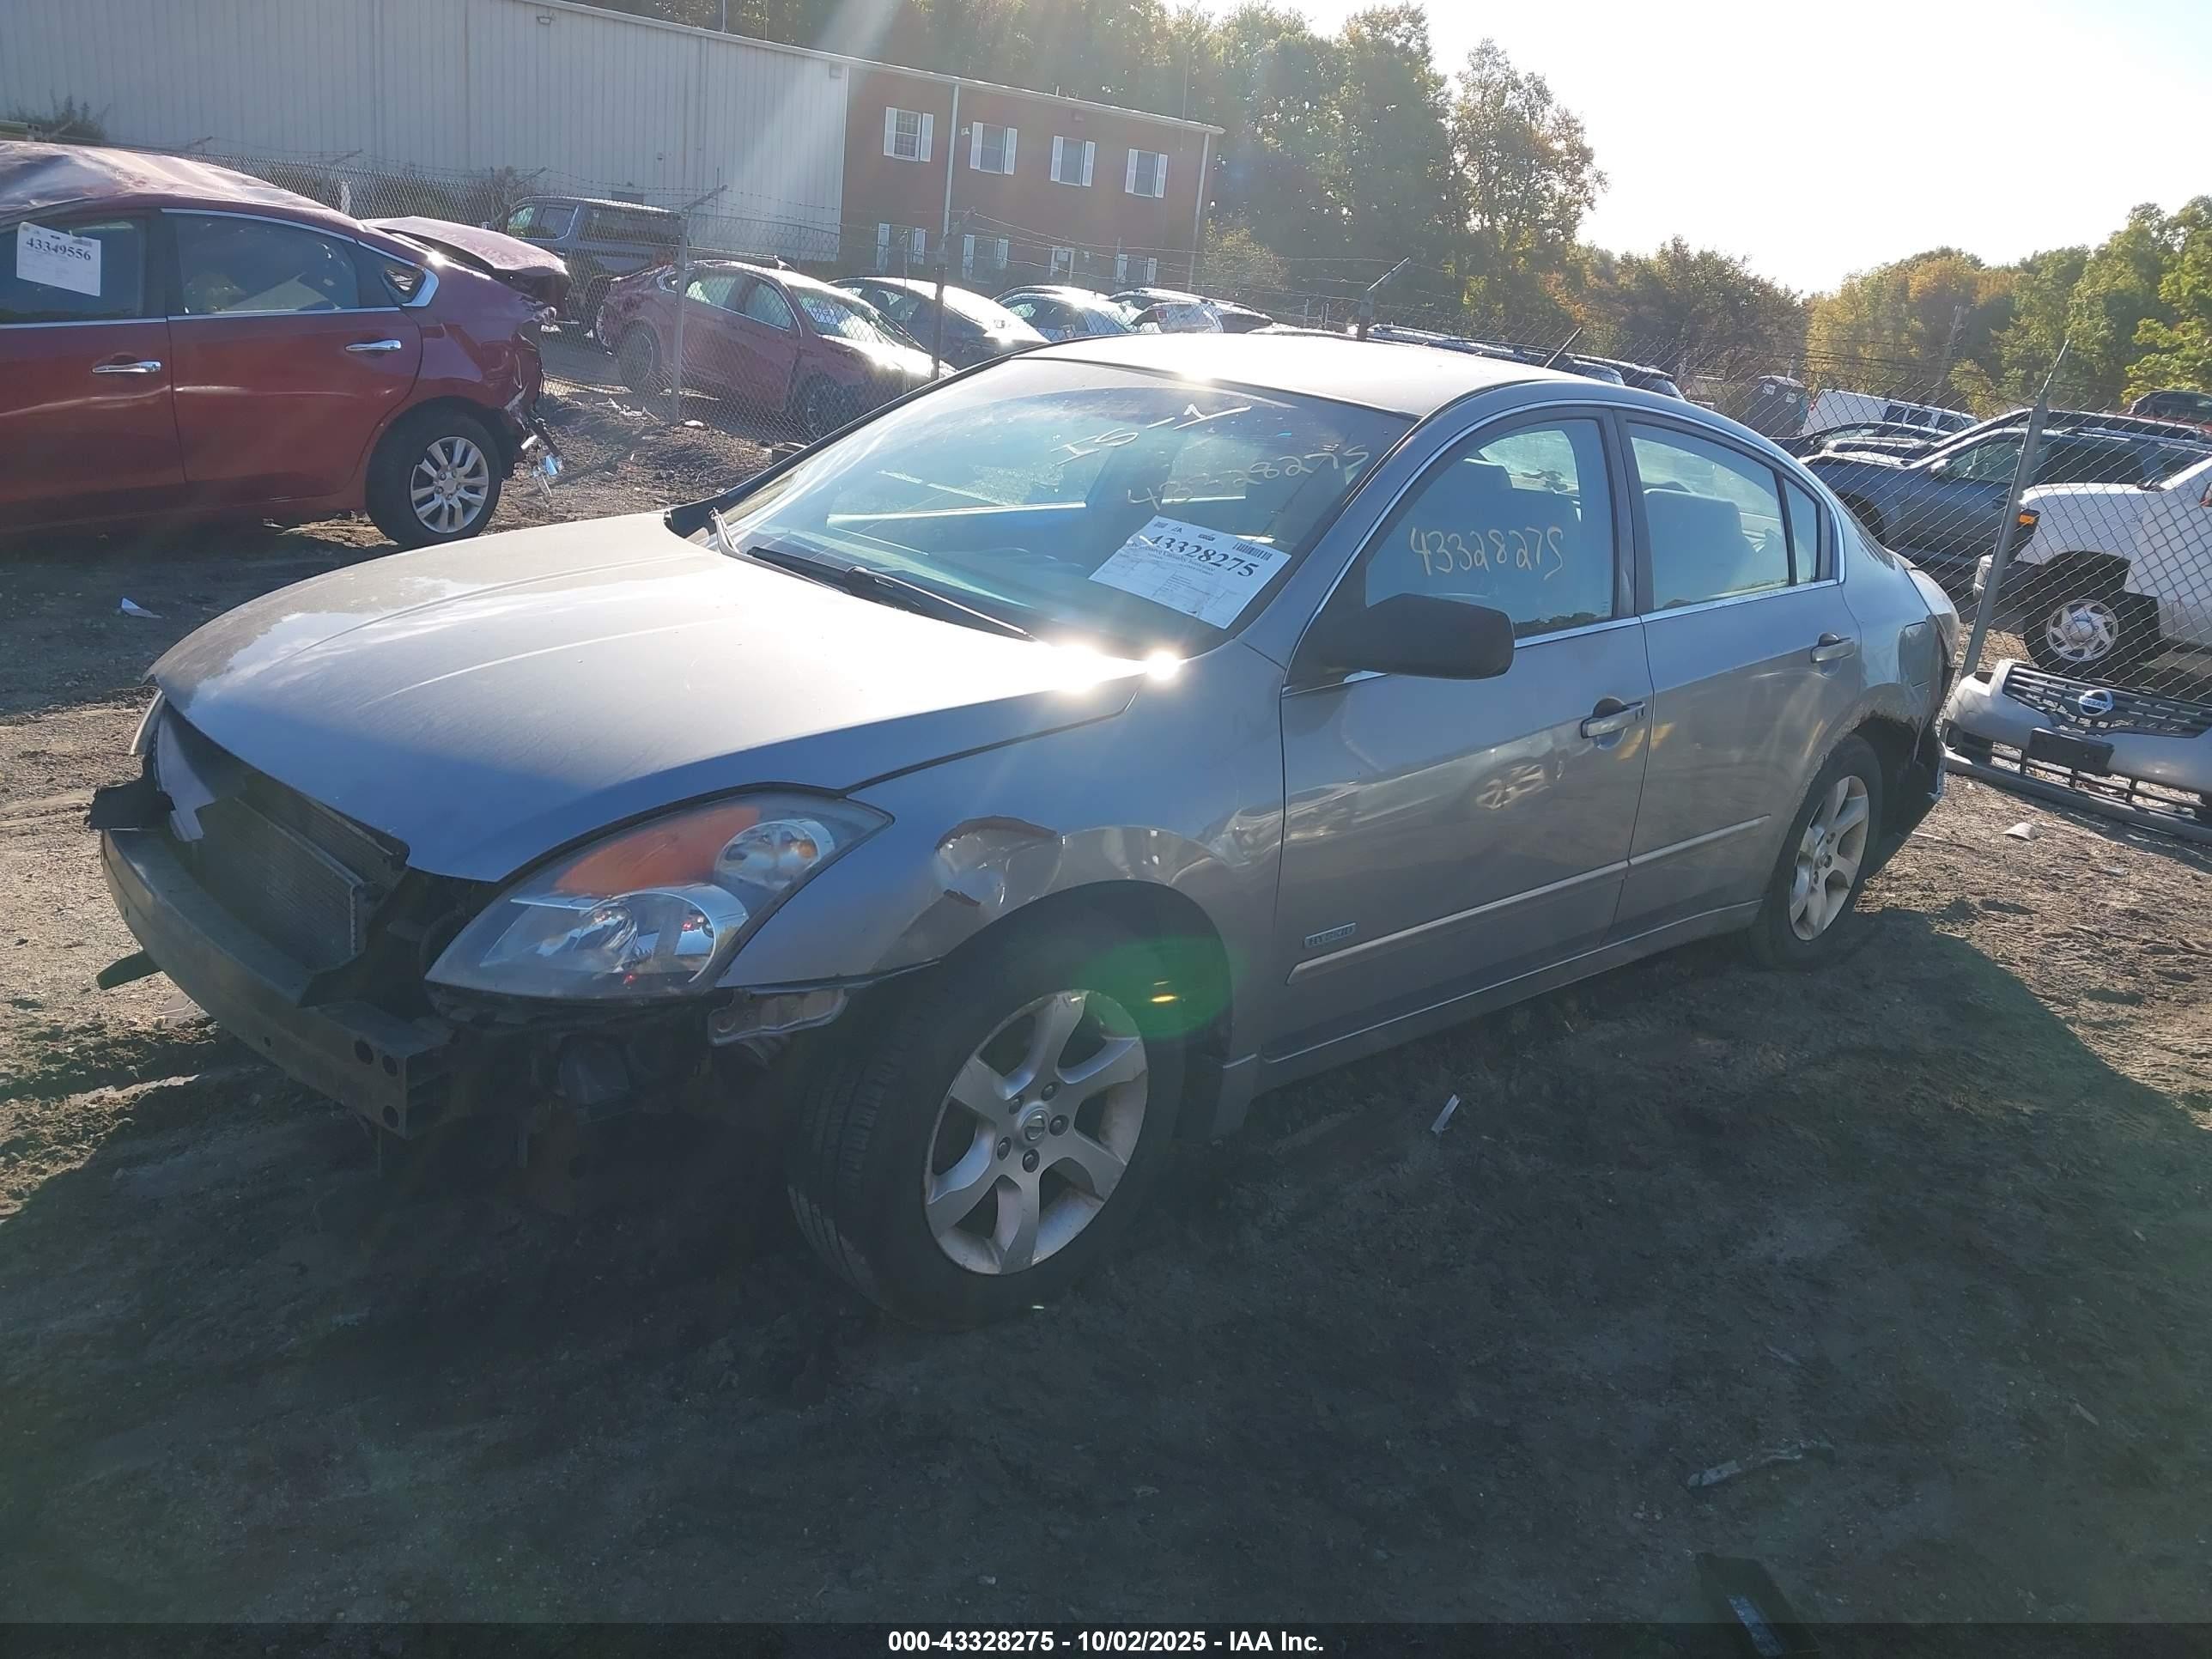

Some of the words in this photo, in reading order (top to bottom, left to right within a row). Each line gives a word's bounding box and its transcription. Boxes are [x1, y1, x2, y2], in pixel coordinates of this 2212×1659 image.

[27, 237, 91, 261] 43349556
[1150, 534, 1259, 577] 43328275
[1410, 526, 1565, 580] 43328275
